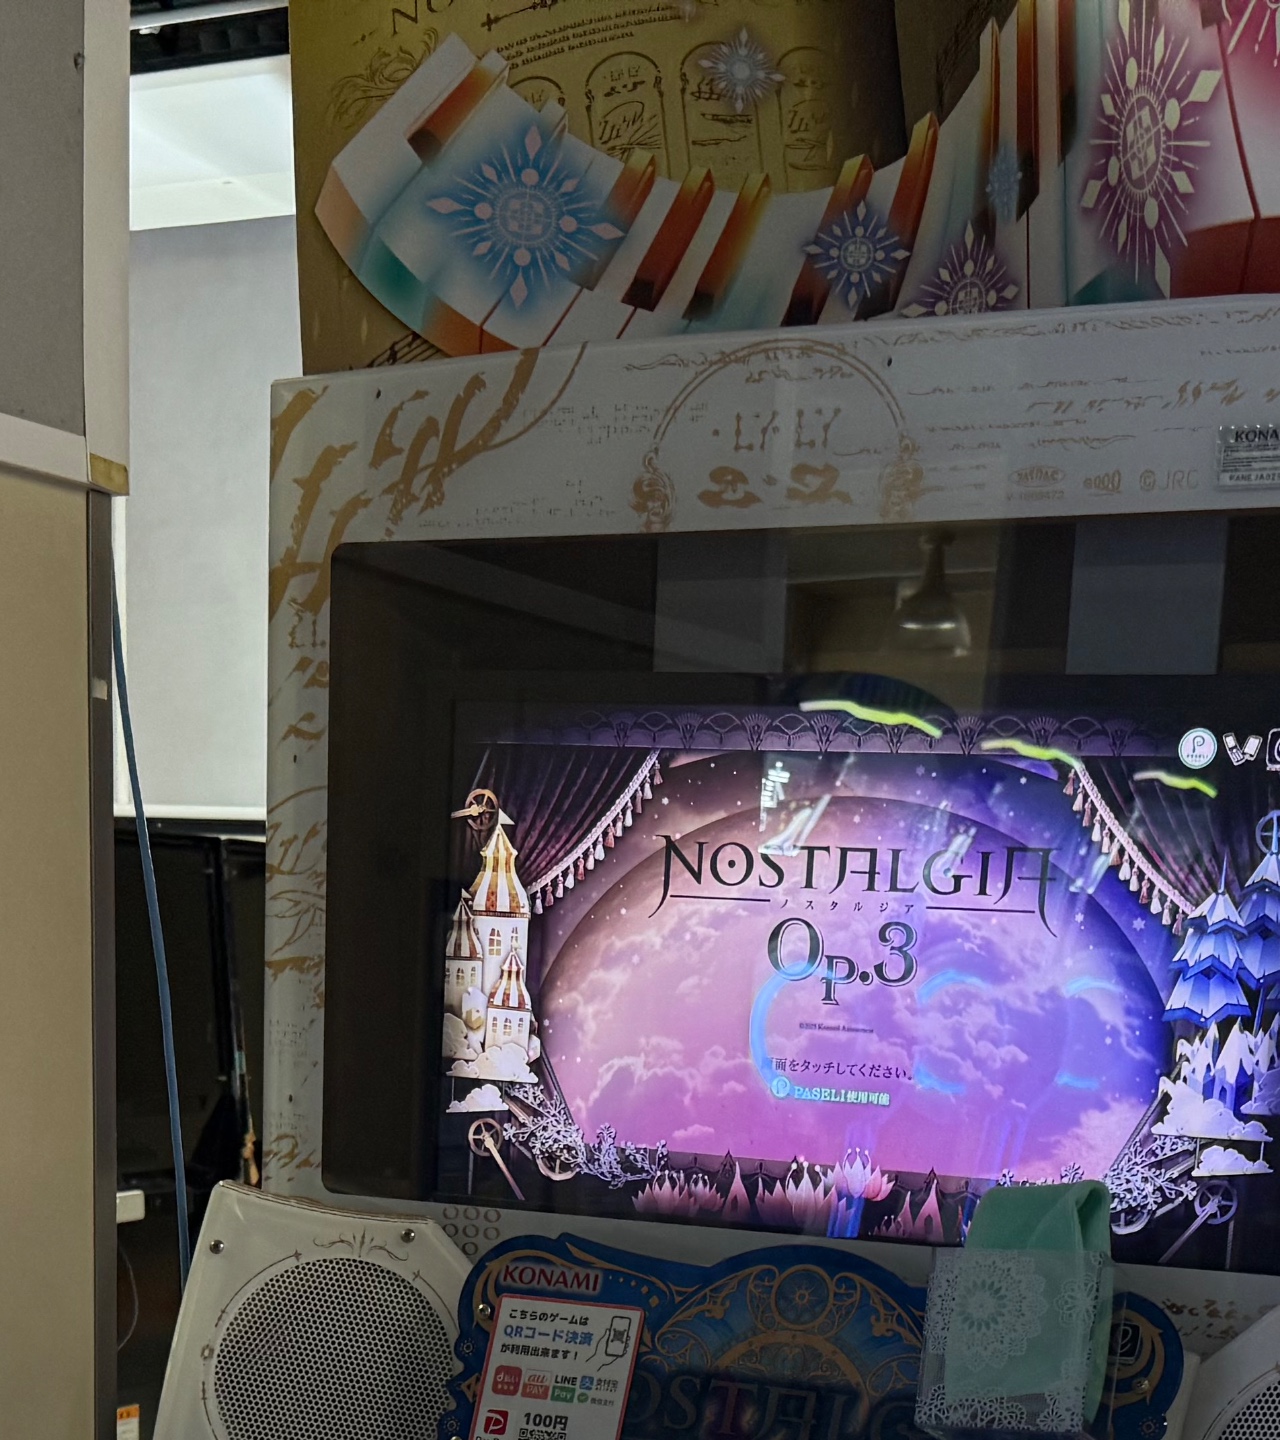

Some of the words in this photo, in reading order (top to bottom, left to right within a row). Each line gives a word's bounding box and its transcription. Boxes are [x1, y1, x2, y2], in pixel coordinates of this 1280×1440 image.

[648, 833, 1061, 938] NOSTALGIA
[779, 898, 915, 915] ノスタルジア
[766, 916, 919, 1006] Op.3
[502, 1264, 600, 1292] KONAMI
[509, 1308, 590, 1327] こちらのゲームは
[503, 1324, 594, 1347] QRコード決済
[554, 1374, 578, 1386] LINE
[554, 1389, 572, 1399] Pay
[523, 1411, 569, 1431] 100円
